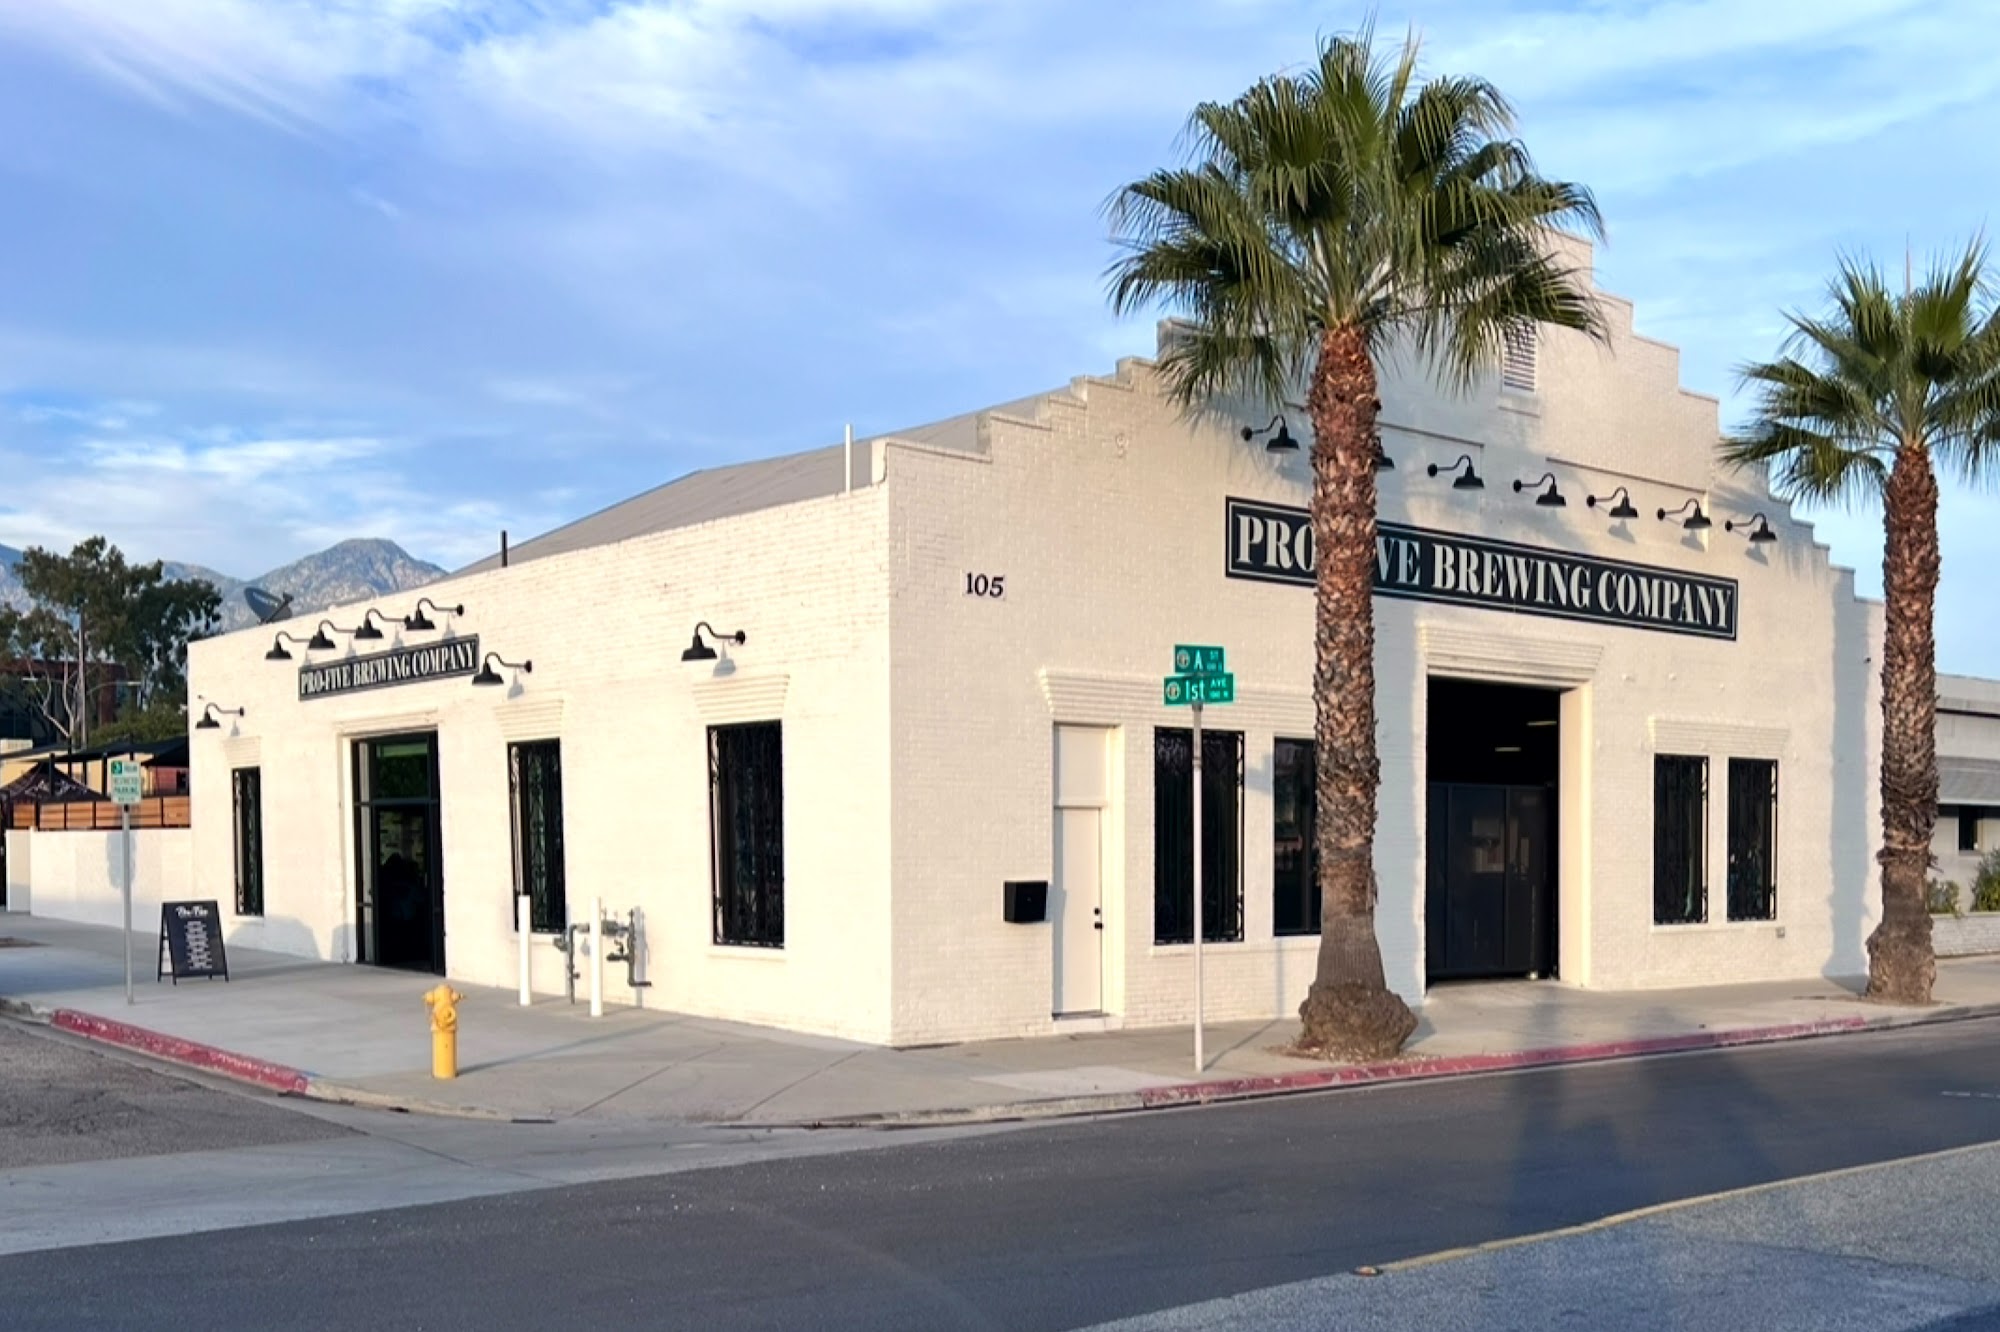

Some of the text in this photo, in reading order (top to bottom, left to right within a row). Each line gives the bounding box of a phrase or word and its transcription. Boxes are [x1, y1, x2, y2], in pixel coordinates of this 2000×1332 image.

[967, 571, 1003, 598] 105
[1236, 513, 1732, 629] PROVE BREWING COMPANY
[301, 642, 476, 694] PRO-FIVE BREWING COMPANY
[1194, 649, 1203, 670] A
[1185, 680, 1205, 701] 1st
[1210, 677, 1226, 689] AVE
